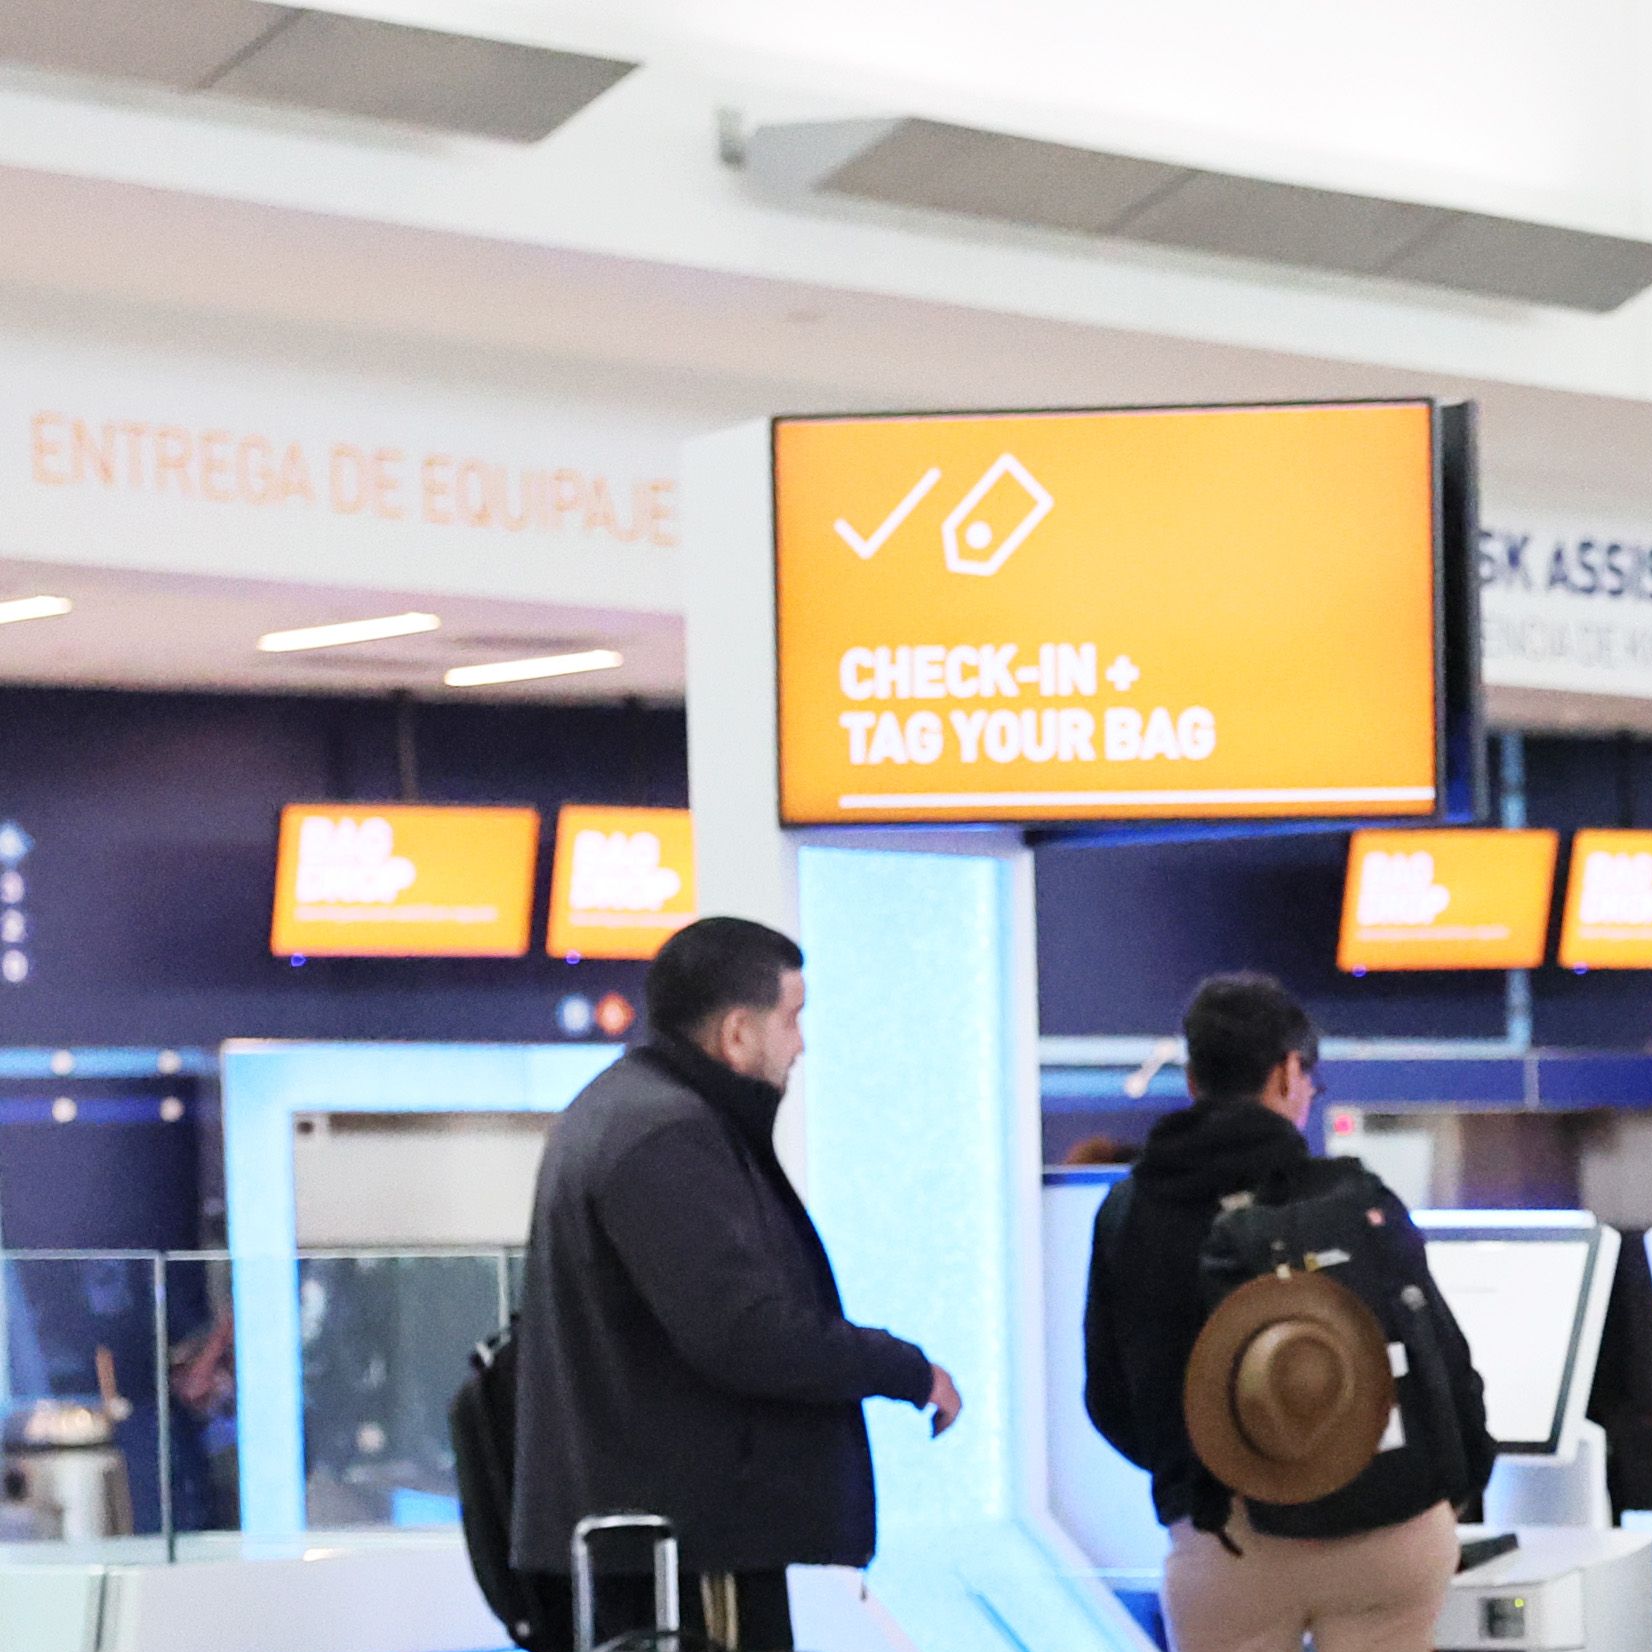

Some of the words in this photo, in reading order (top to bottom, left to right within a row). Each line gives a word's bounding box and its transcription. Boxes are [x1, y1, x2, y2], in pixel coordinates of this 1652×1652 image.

[30, 408, 313, 508] ENTREGA
[328, 441, 404, 520] DE
[420, 455, 681, 547] EQUIPAJE
[839, 643, 1097, 700] CHECK-IN
[838, 710, 943, 766] TAG
[949, 708, 1096, 763] YOUR
[1104, 705, 1217, 761] BAG
